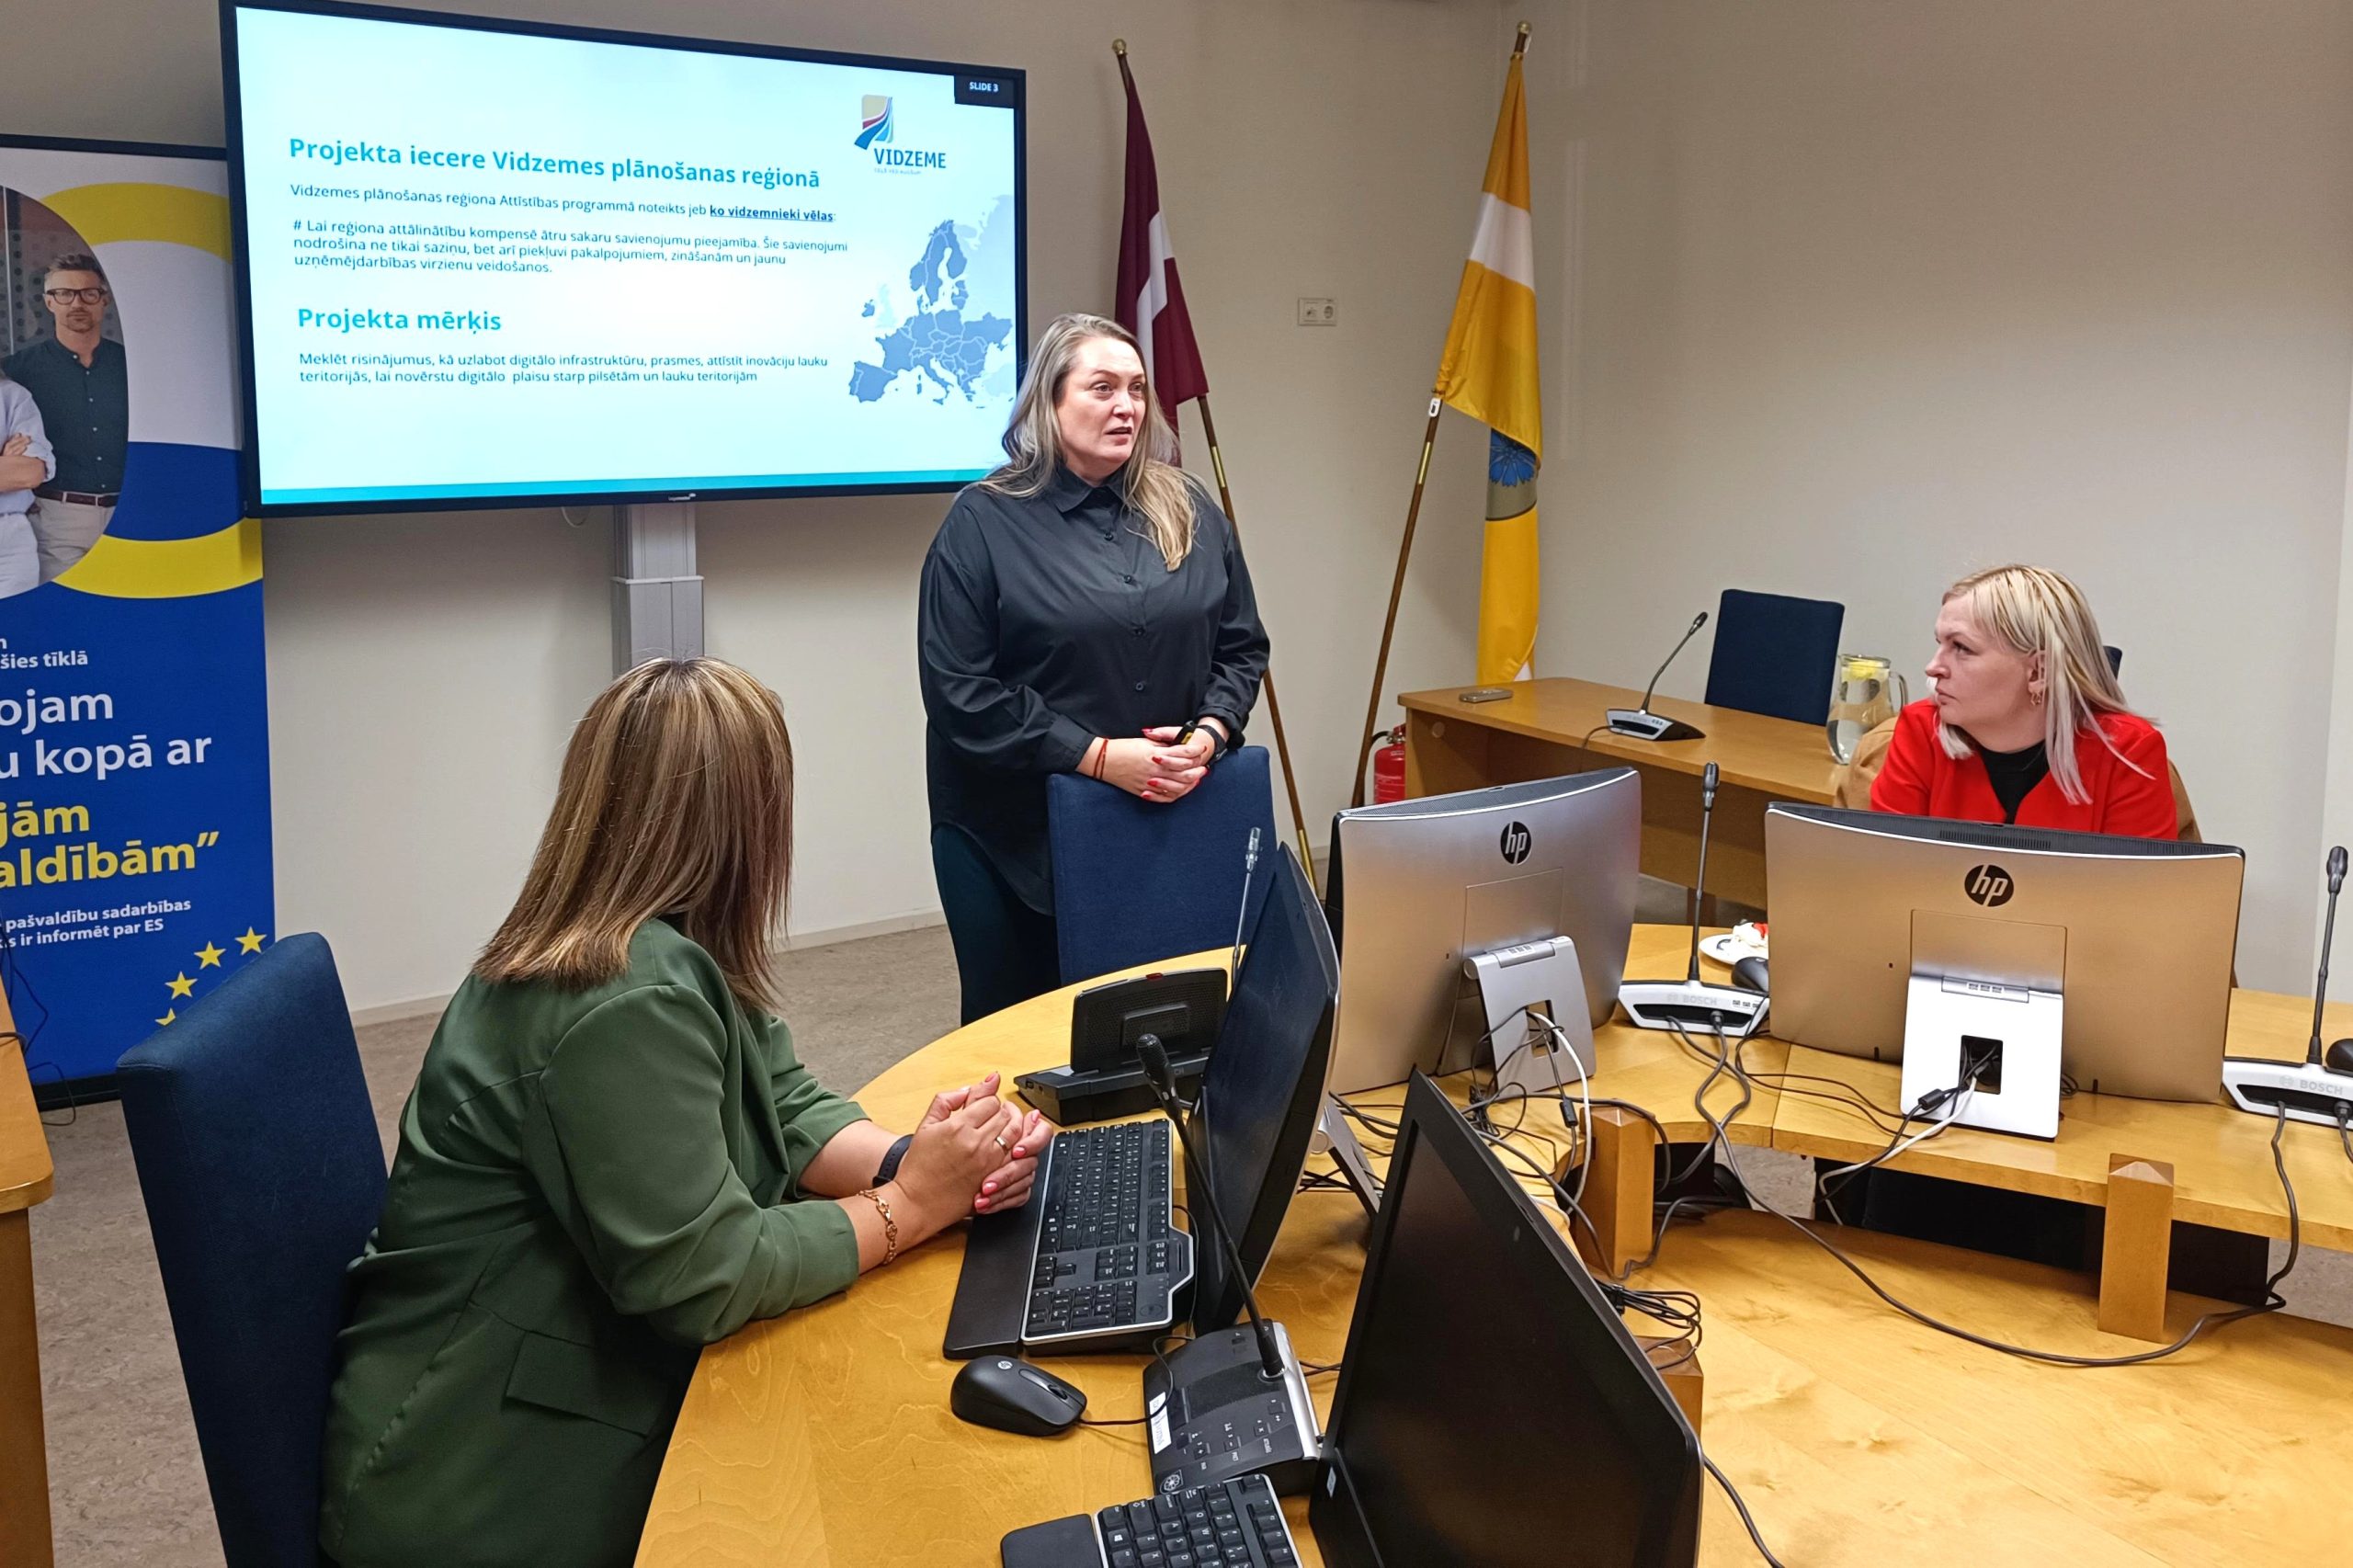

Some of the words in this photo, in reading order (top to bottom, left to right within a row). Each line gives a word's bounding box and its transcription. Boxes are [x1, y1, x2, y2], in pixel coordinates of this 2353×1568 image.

[970, 81, 992, 92] SLIDE
[993, 83, 999, 93] 3
[290, 138, 402, 165] Projekta
[410, 144, 485, 169] iecere
[492, 151, 606, 176] Vidzemes
[611, 157, 735, 182] plānošanas
[742, 166, 820, 189] reģionā
[874, 148, 947, 169] VIDZEME
[290, 184, 359, 199] Vidzemes
[364, 187, 442, 203] plānošanas
[446, 192, 496, 208] reģiona
[499, 195, 559, 209] Attīstības
[562, 200, 635, 213] programmā
[638, 203, 686, 215] noteikts
[688, 204, 707, 218] jeb
[710, 204, 725, 217] ko
[728, 206, 801, 221] vidzemnieki
[293, 220, 301, 231] #
[307, 221, 327, 232] Lai
[332, 222, 384, 236] reģiona
[389, 224, 466, 238] attālinātību
[470, 226, 538, 242] kompensē
[540, 230, 567, 242] ātru
[570, 231, 611, 243] sakaru
[615, 234, 691, 247] savienojumu
[694, 236, 760, 249] pieejamība.
[763, 235, 779, 249] Šie
[783, 241, 847, 253] savienojumi
[294, 237, 365, 249] nodrošina
[370, 241, 388, 252] ne
[392, 240, 420, 253] tikai
[424, 243, 471, 256] saziņu,
[472, 243, 495, 256] bet
[498, 244, 517, 256] arī
[518, 245, 568, 259] piekļuvi
[571, 247, 667, 262] pakalpojumiem,
[671, 250, 733, 262] zināšanām
[735, 255, 751, 263] un
[754, 254, 786, 267] jaunu
[294, 256, 417, 270] uzņēmējdarbības
[419, 259, 474, 271] virzienu
[476, 260, 551, 272] veidošanos.
[298, 308, 409, 333] Projekta
[416, 311, 502, 335] mērķis
[299, 353, 347, 367] Meklēt
[351, 354, 435, 368] risinājumus,
[438, 354, 455, 366] kā
[458, 354, 506, 367] uzlabot
[509, 354, 557, 369] digitālo
[559, 354, 647, 368] infrastruktūru,
[650, 358, 703, 369] prasmes,
[707, 356, 743, 367] attīstīt
[746, 356, 795, 369] inovāciju
[798, 356, 828, 367] lauku
[300, 370, 371, 385] teritorijās,
[375, 370, 391, 382] lai
[395, 371, 454, 382] novērstu
[458, 370, 506, 386] digitālo
[513, 370, 551, 385] plaisu
[553, 372, 585, 385] starp
[588, 371, 640, 384] pilsētām
[643, 373, 659, 381] un
[662, 370, 694, 381] lauku
[698, 370, 757, 384] teritorijām
[0, 653, 39, 669] šies
[42, 650, 88, 667] tīklā
[0, 688, 114, 735] ojam
[35, 734, 153, 780] kopā
[166, 737, 212, 766] ar
[1500, 821, 1532, 865] hp
[6, 908, 98, 933] pašvaldību
[102, 900, 191, 919] sadarbības
[20, 933, 33, 946] ir
[36, 925, 109, 945] informēt
[113, 922, 142, 938] par
[144, 918, 164, 932] ES
[2300, 1079, 2343, 1096] BOSCH
